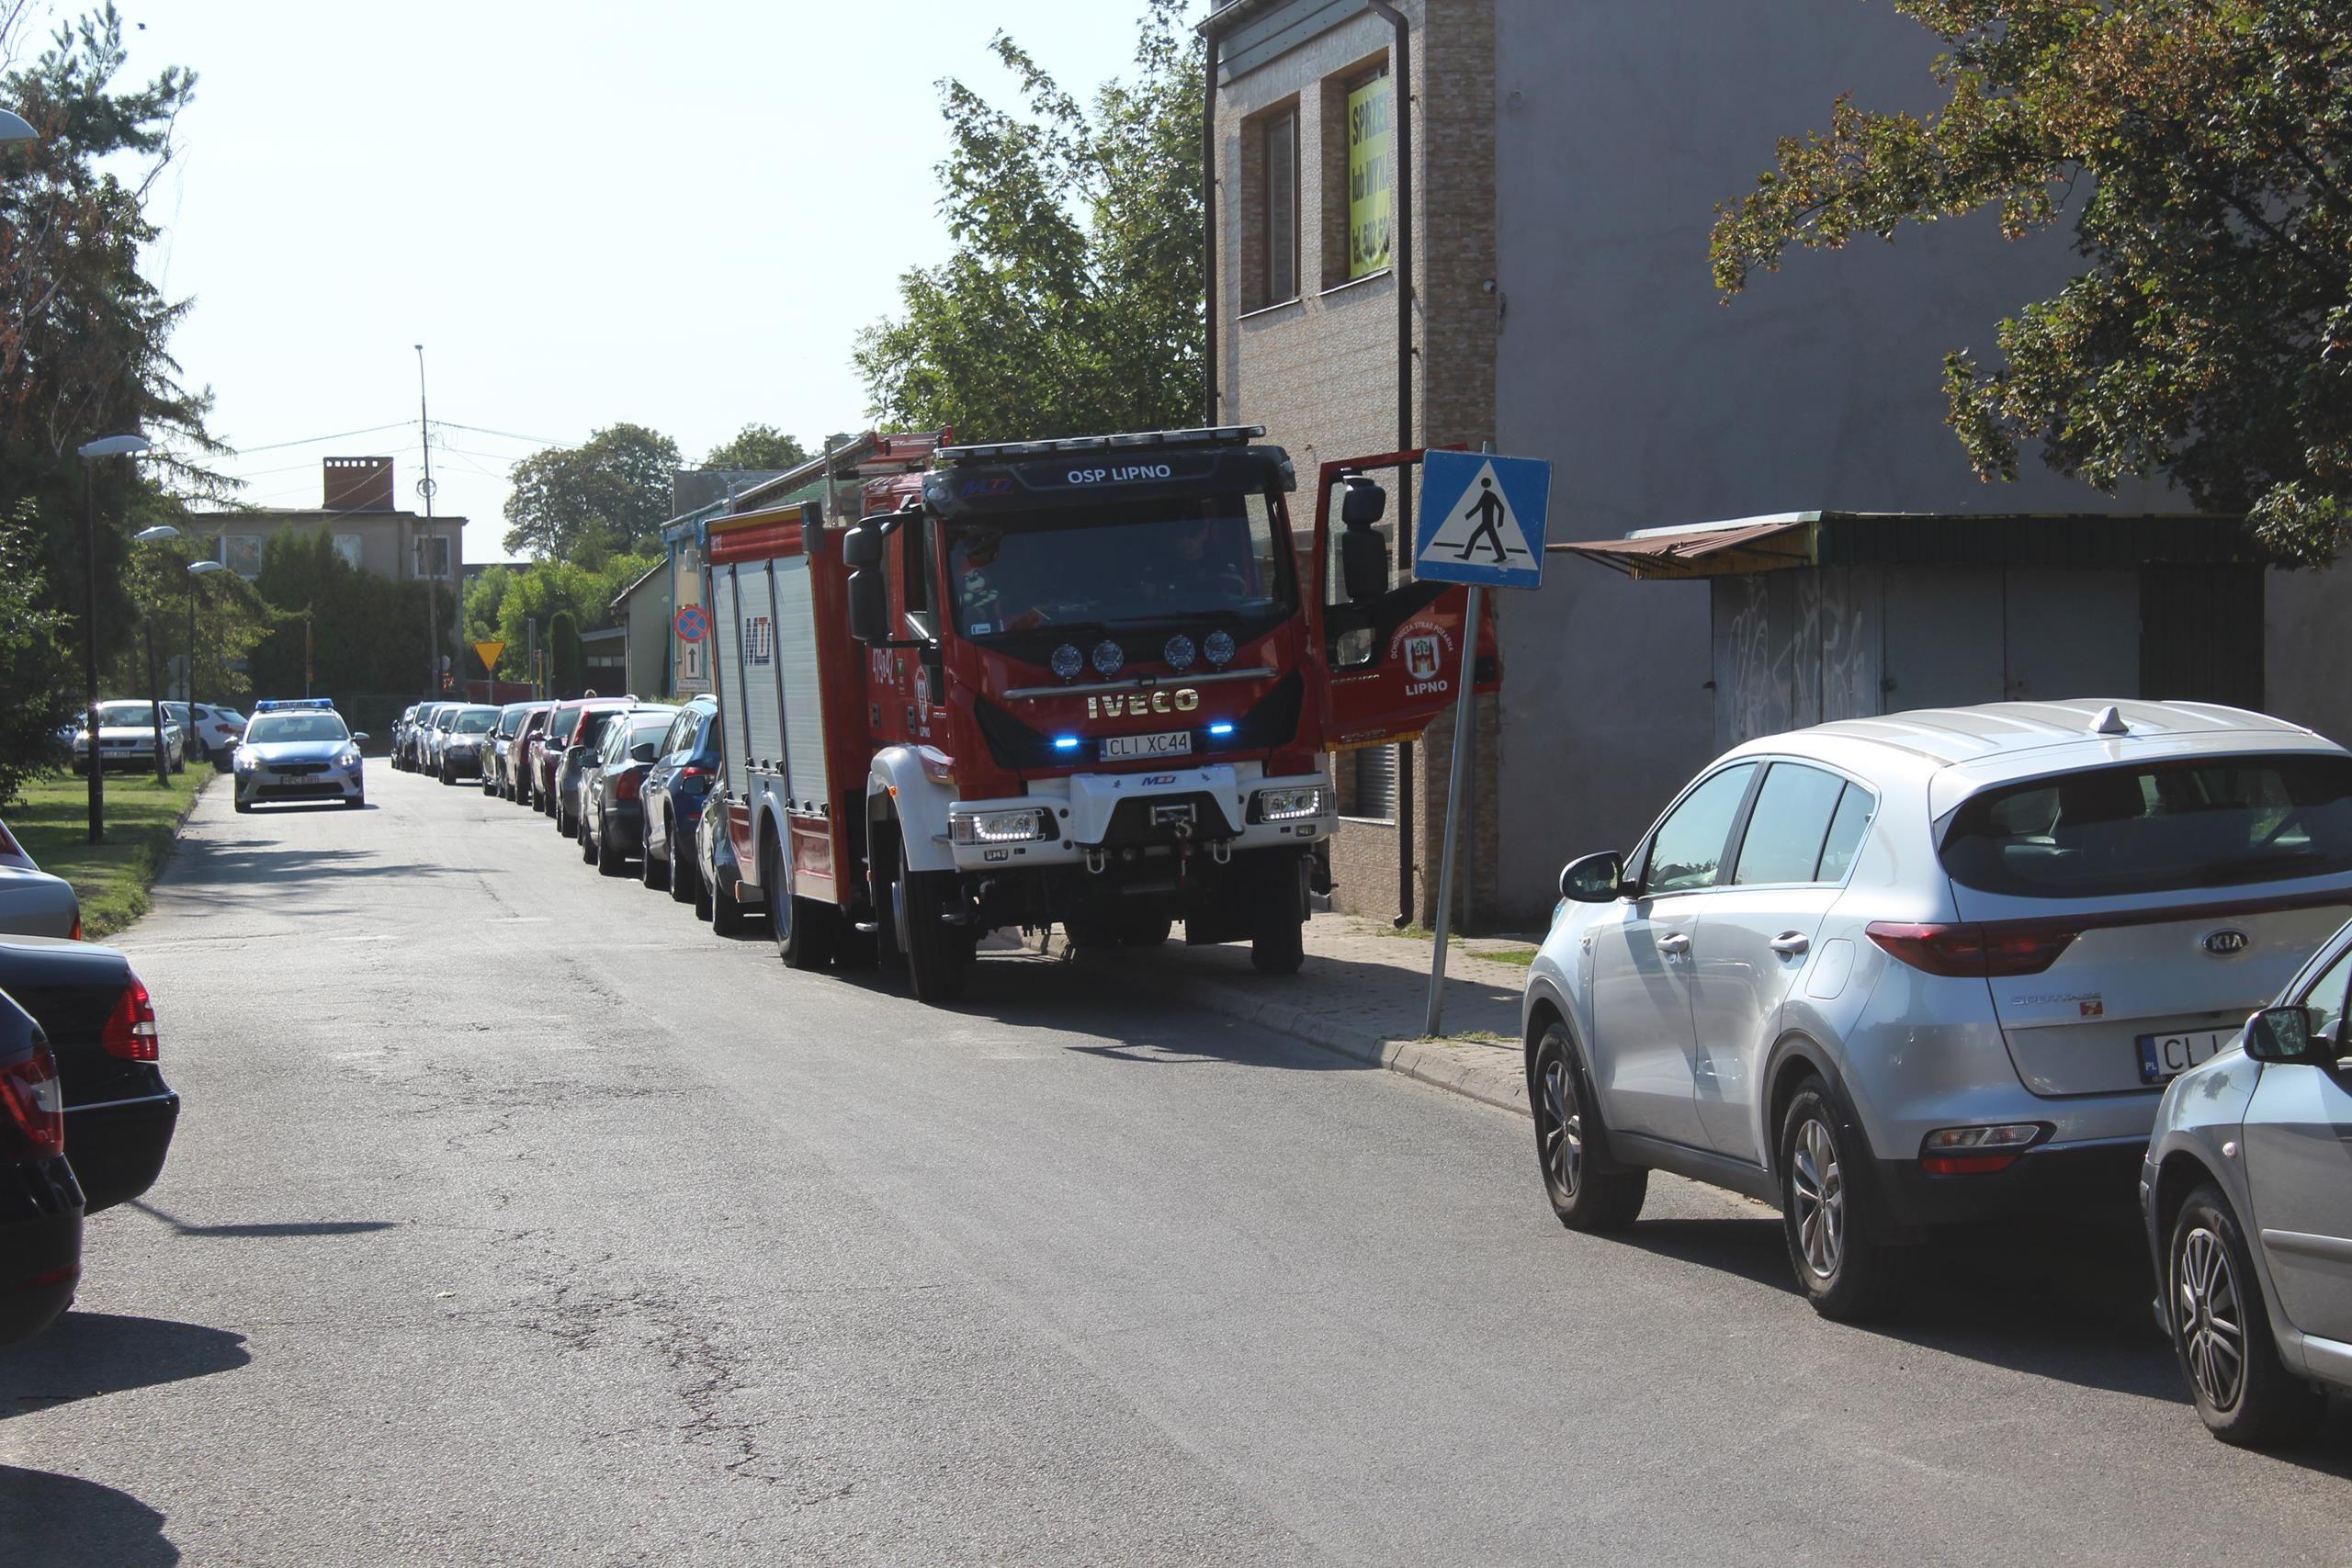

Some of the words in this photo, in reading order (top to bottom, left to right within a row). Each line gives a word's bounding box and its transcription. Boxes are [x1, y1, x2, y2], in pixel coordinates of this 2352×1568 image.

[1352, 164, 1364, 202] lub
[1068, 468, 1106, 484] OSP
[1112, 464, 1171, 481] LIPNO
[1405, 680, 1448, 696] LIPNO
[1087, 688, 1200, 719] IVECO
[1110, 736, 1140, 755] CLI
[1147, 734, 1189, 752] XC44
[2211, 935, 2244, 950] KIA
[2145, 1061, 2157, 1071] PL
